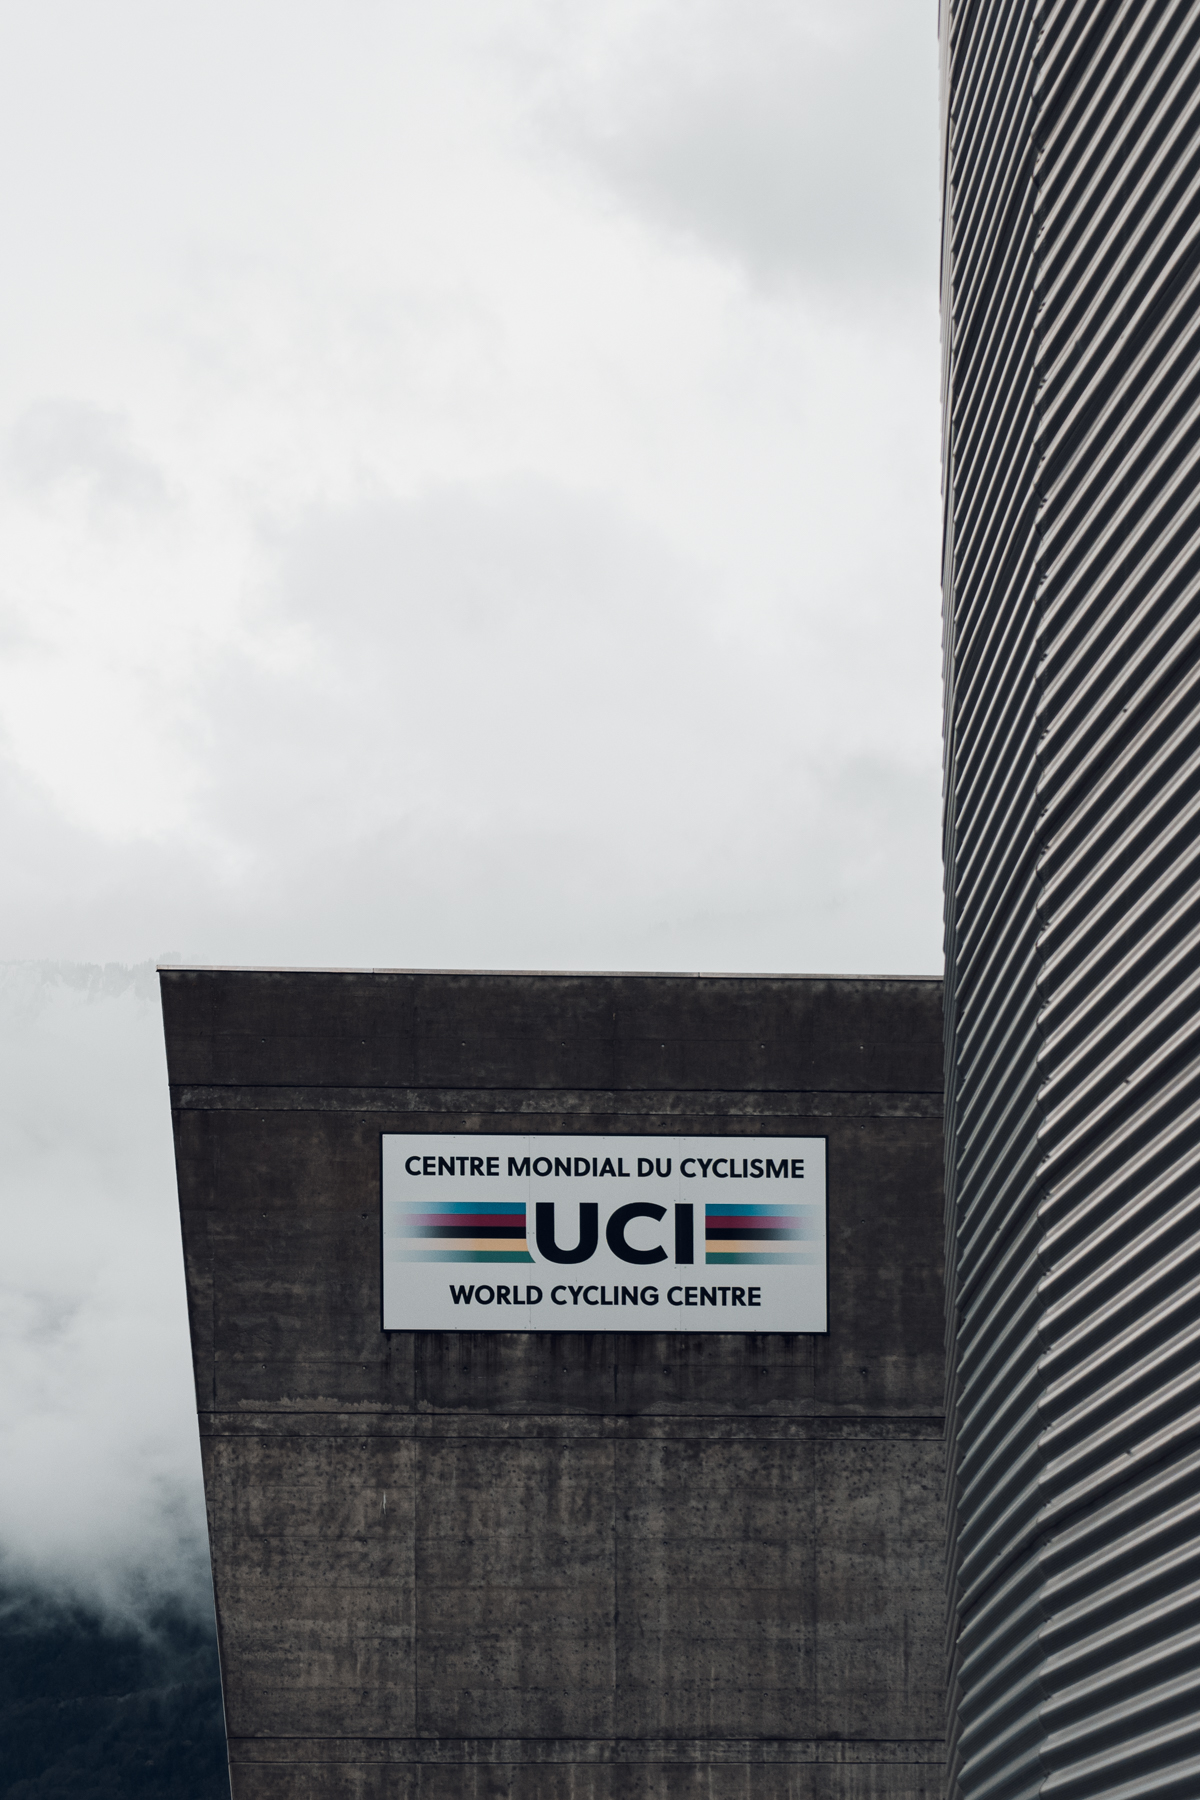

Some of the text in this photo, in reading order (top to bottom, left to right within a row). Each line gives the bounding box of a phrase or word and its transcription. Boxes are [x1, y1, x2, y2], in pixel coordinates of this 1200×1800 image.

[404, 1156, 805, 1179] CENTRE MONDIAL DU CYCLISME
[535, 1202, 695, 1265] UCI
[448, 1284, 762, 1307] WORLD CYCLING CENTRE
